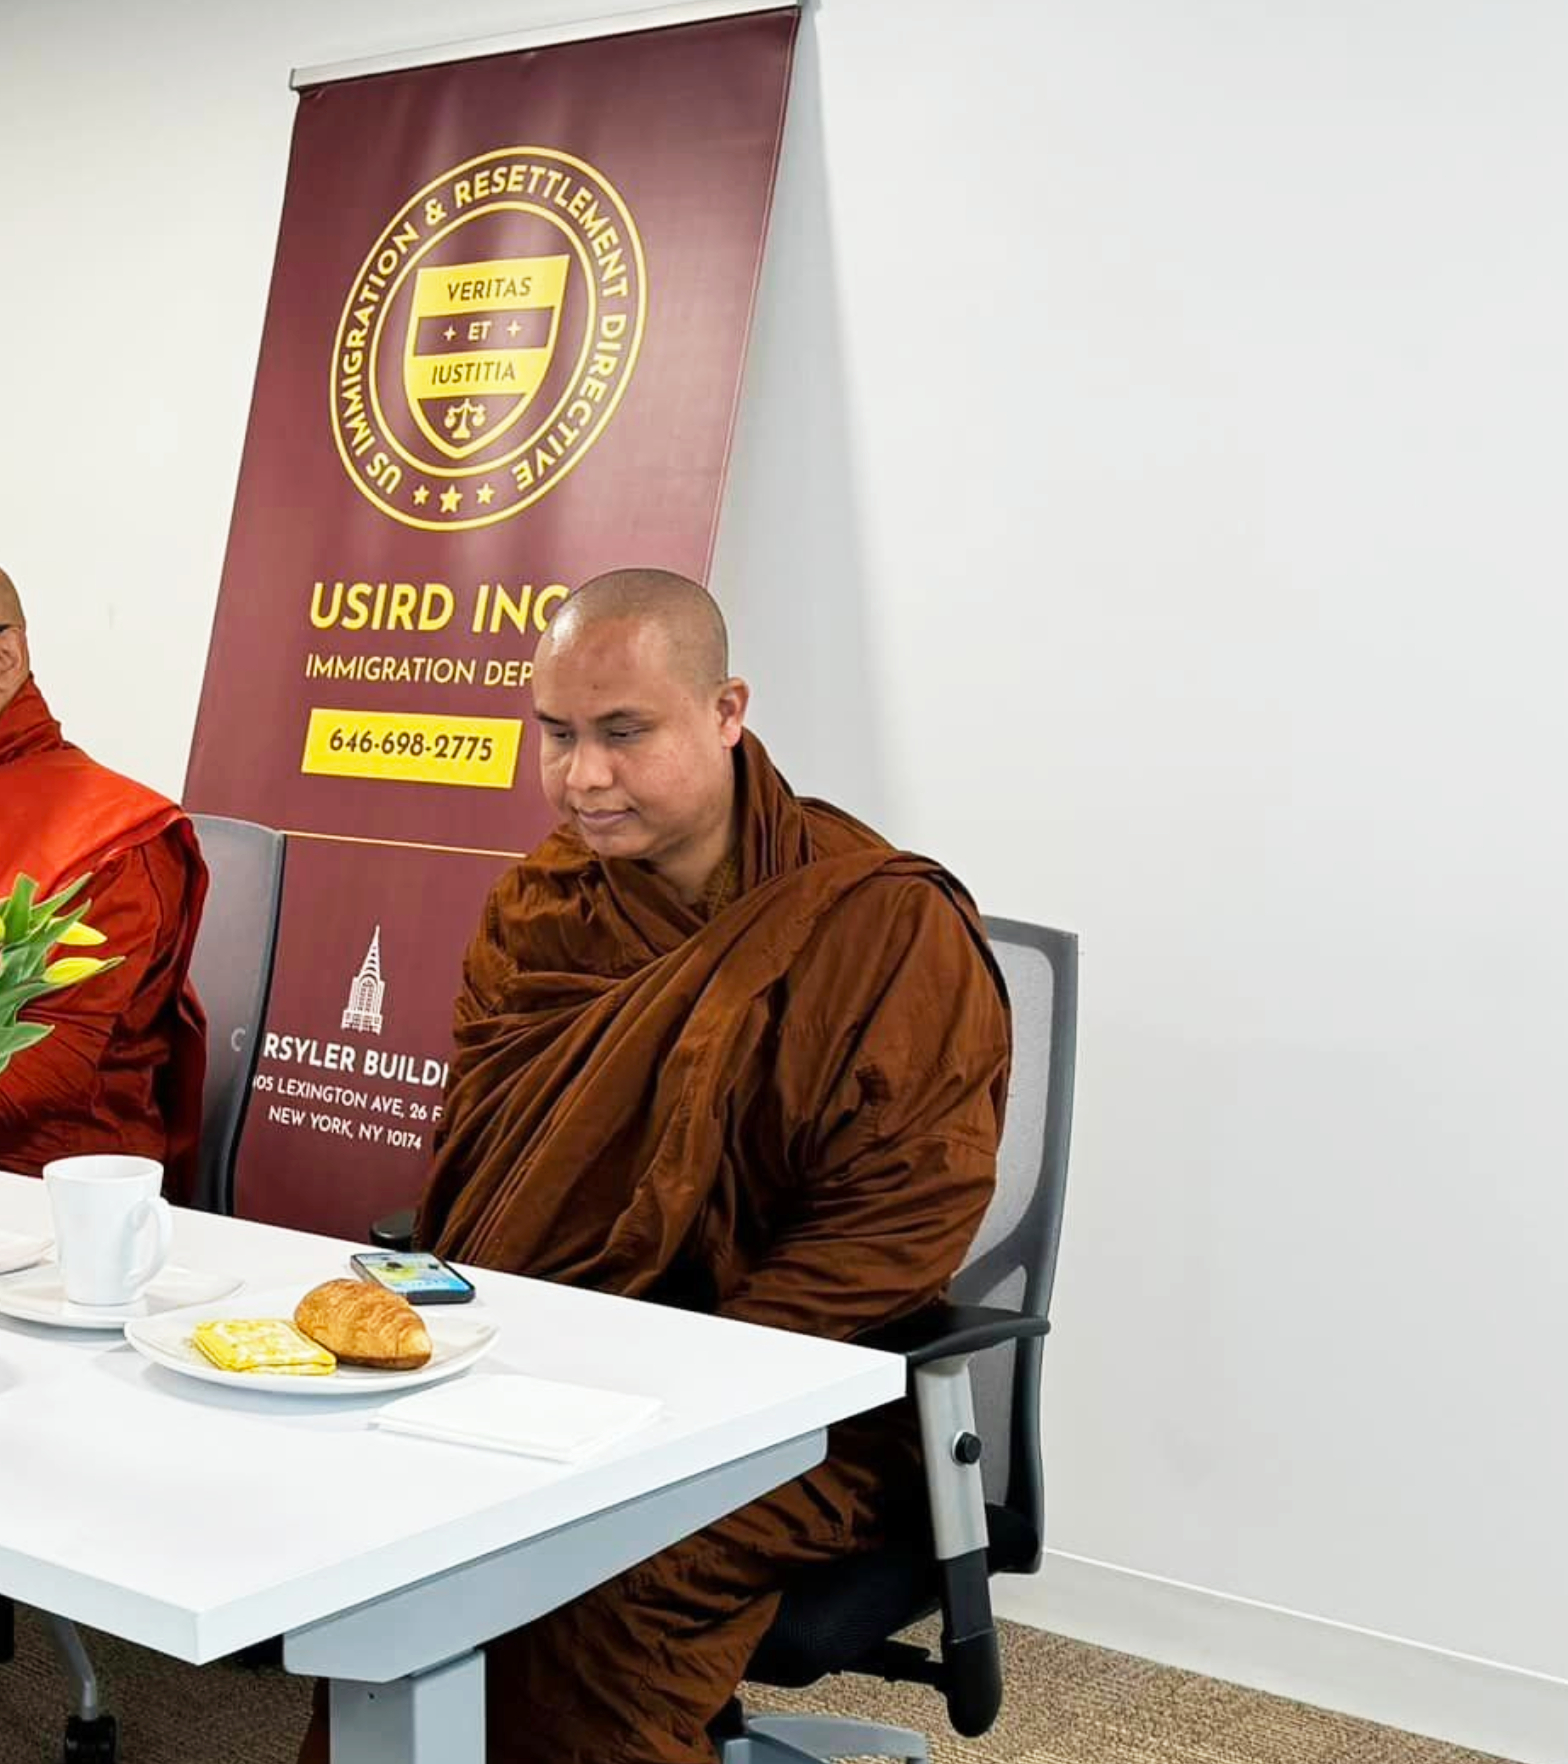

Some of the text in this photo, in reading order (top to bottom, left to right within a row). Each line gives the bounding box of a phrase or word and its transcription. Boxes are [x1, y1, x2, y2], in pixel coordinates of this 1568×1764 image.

[447, 276, 532, 302] VERITAS
[341, 163, 628, 494] US IMMIGRATION & RESETTLEMENT DIRECTIVE
[468, 321, 492, 341] ET
[431, 360, 517, 386] IUSTITIA
[310, 581, 455, 631] USIRD
[305, 653, 533, 687] IMMIGRATION DEP
[329, 729, 493, 761] 646-698-2775
[231, 1027, 449, 1089] CRSYLER BUILDI
[277, 1077, 368, 1109] LEXINGTON
[370, 1094, 405, 1119] AVE,
[409, 1101, 428, 1121] 26
[431, 1104, 444, 1123] F
[268, 1104, 423, 1150] NEW YORK, NY 10174
